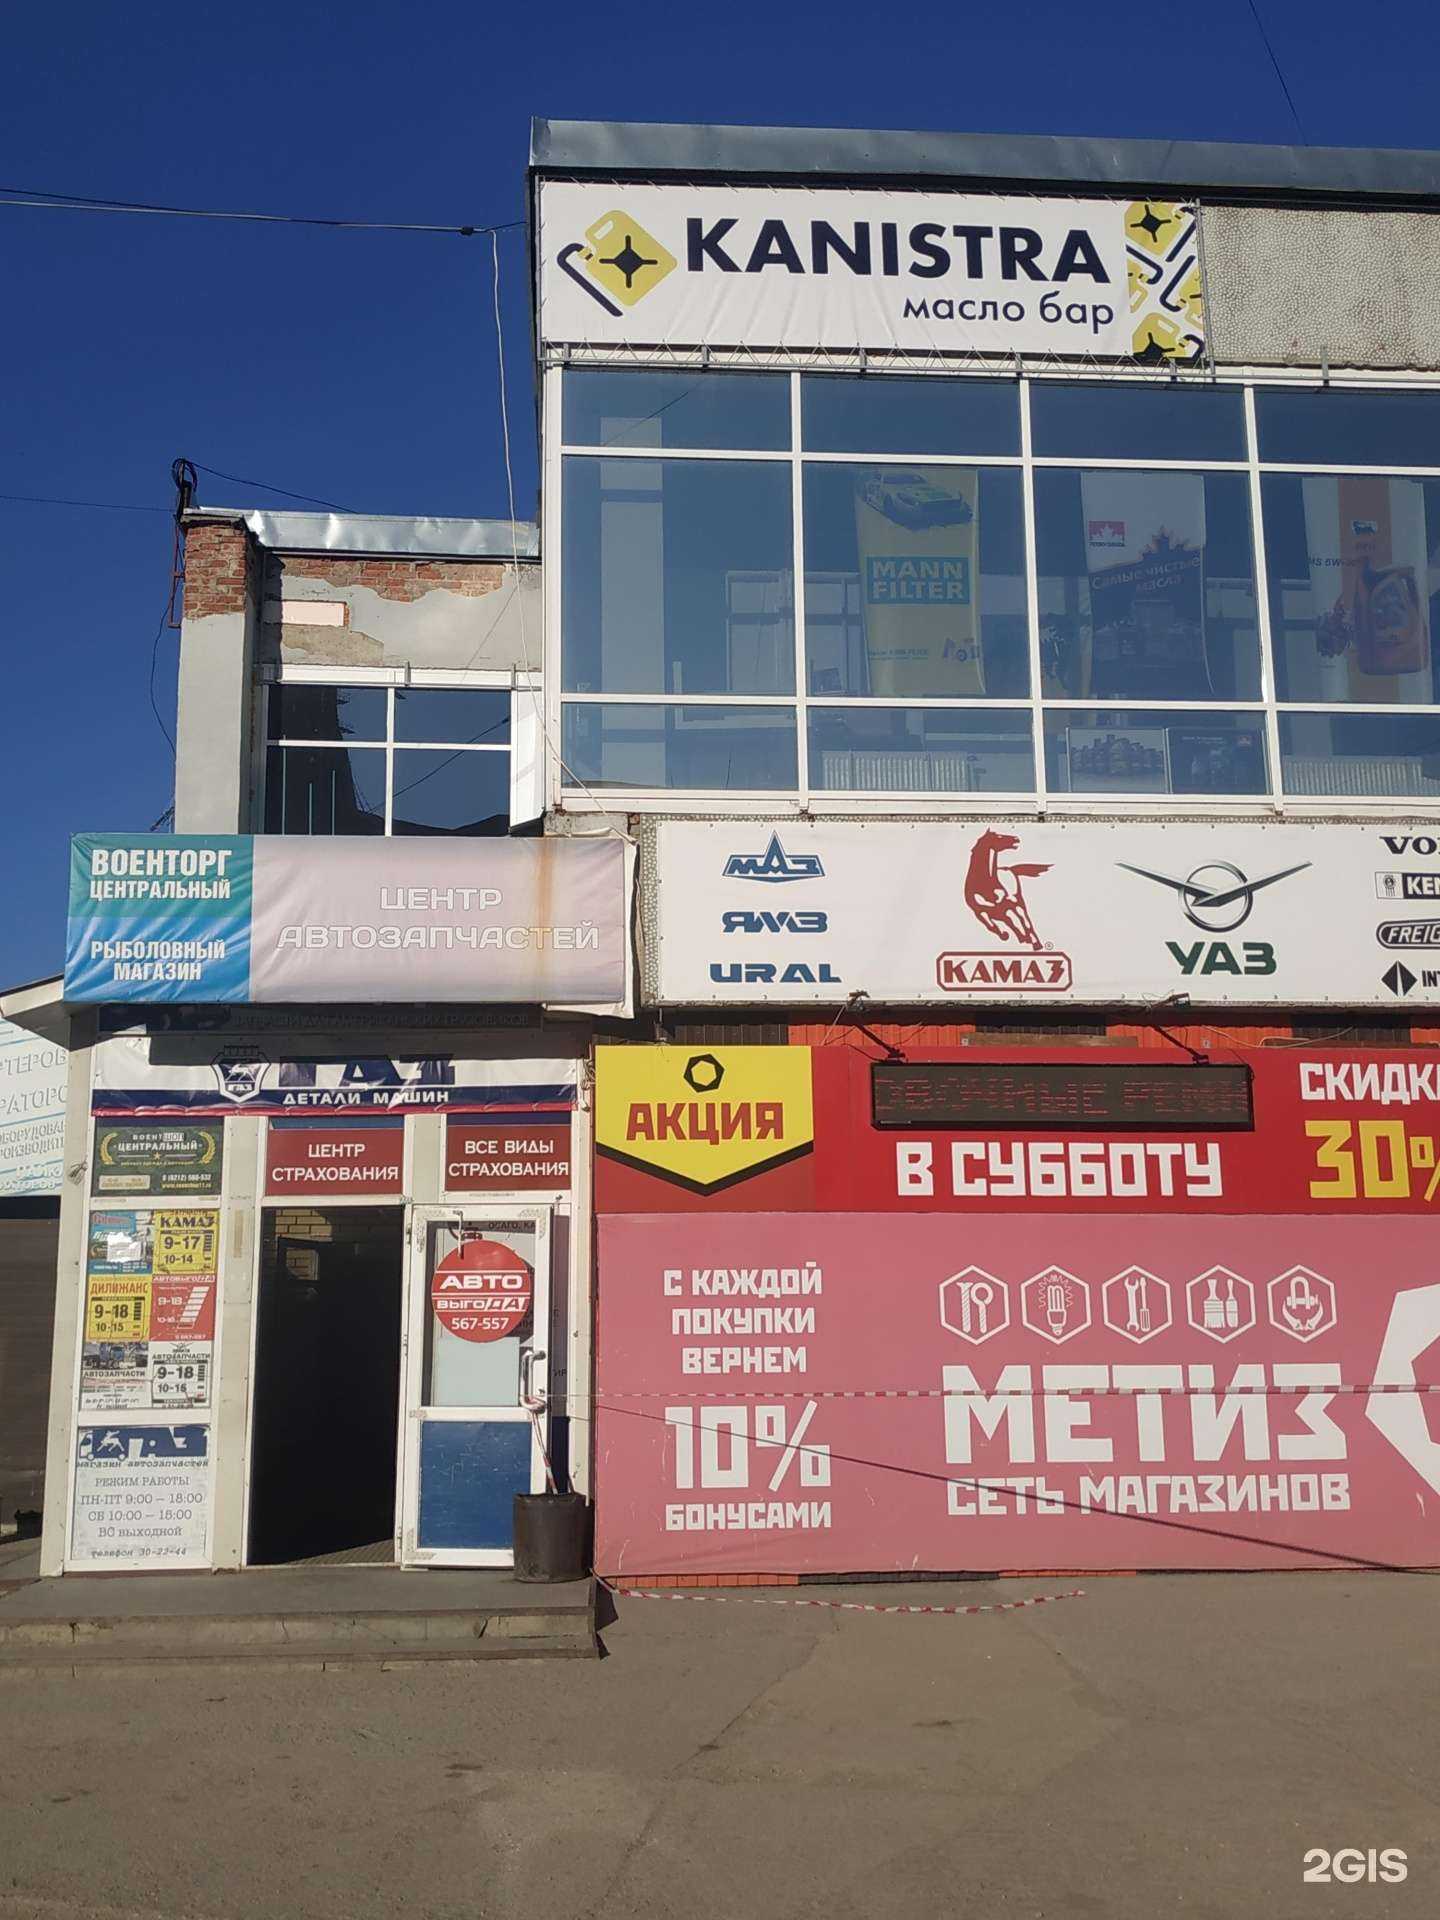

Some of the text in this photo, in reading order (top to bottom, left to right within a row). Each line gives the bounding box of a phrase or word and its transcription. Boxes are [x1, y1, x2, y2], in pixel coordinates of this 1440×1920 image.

[687, 217, 1110, 283] KANISTRA
[903, 291, 1113, 334] масло бар
[872, 560, 962, 578] MANN
[872, 581, 964, 599] FILTER
[1379, 836, 1440, 855] VO
[92, 848, 232, 876] ВОЕНТОРГ
[90, 876, 231, 900] ЦЕНТРАЛЬНЫЙ
[380, 886, 503, 912] ЦЕНТР
[276, 920, 600, 951] АВТОЗАПЧАСТЕЙ
[91, 937, 226, 960] РЫБОЛОВНЫЙ
[1165, 941, 1278, 976] УАЗ
[113, 960, 202, 981] МАГАЗИН
[710, 963, 842, 983] URAL
[283, 1090, 449, 1105] ДЕТАЛИ МАШИН
[626, 1102, 784, 1146] АКЦИЯ
[118, 1140, 198, 1152] ЦЕНТРАЛЬНЫЙ
[308, 1143, 365, 1158] ЦЕНТР
[464, 1140, 553, 1154] ВСЕ ВИДЫ
[272, 1166, 399, 1181] СТРАХОВАНИЯ
[449, 1162, 569, 1177] СТРАХОВАНИЯ
[896, 1142, 1223, 1197] В СУББОТУ
[164, 1235, 201, 1250] 9-17
[164, 1254, 193, 1264] 10-14
[90, 1282, 148, 1295] ДИЛИЖАНС
[440, 1275, 523, 1290] АВТО
[664, 1261, 822, 1298] С КАЖДОЙ
[94, 1304, 129, 1319] 9-18
[95, 1322, 124, 1332] 10-15
[451, 1317, 510, 1330] 567-557
[672, 1307, 815, 1335] ПОКУПКИ
[682, 1346, 806, 1374] ВЕРНЕМ
[84, 1370, 145, 1378] АВТОЗАПЧАСТИ
[158, 1366, 194, 1379] 9-18
[942, 1363, 1347, 1463] МЕТИЗ
[665, 1400, 831, 1491] 10%
[95, 1475, 189, 1487] РЕЖИМ РАБОТЫ
[80, 1494, 122, 1504] ПН-ПТ
[126, 1493, 153, 1504] 9:00
[169, 1492, 203, 1504] 18:00
[947, 1473, 1350, 1515] СЕТЬ МАГАЗИНОВ
[109, 1510, 142, 1521] 10:00
[665, 1502, 832, 1530] БОНУСАМИ
